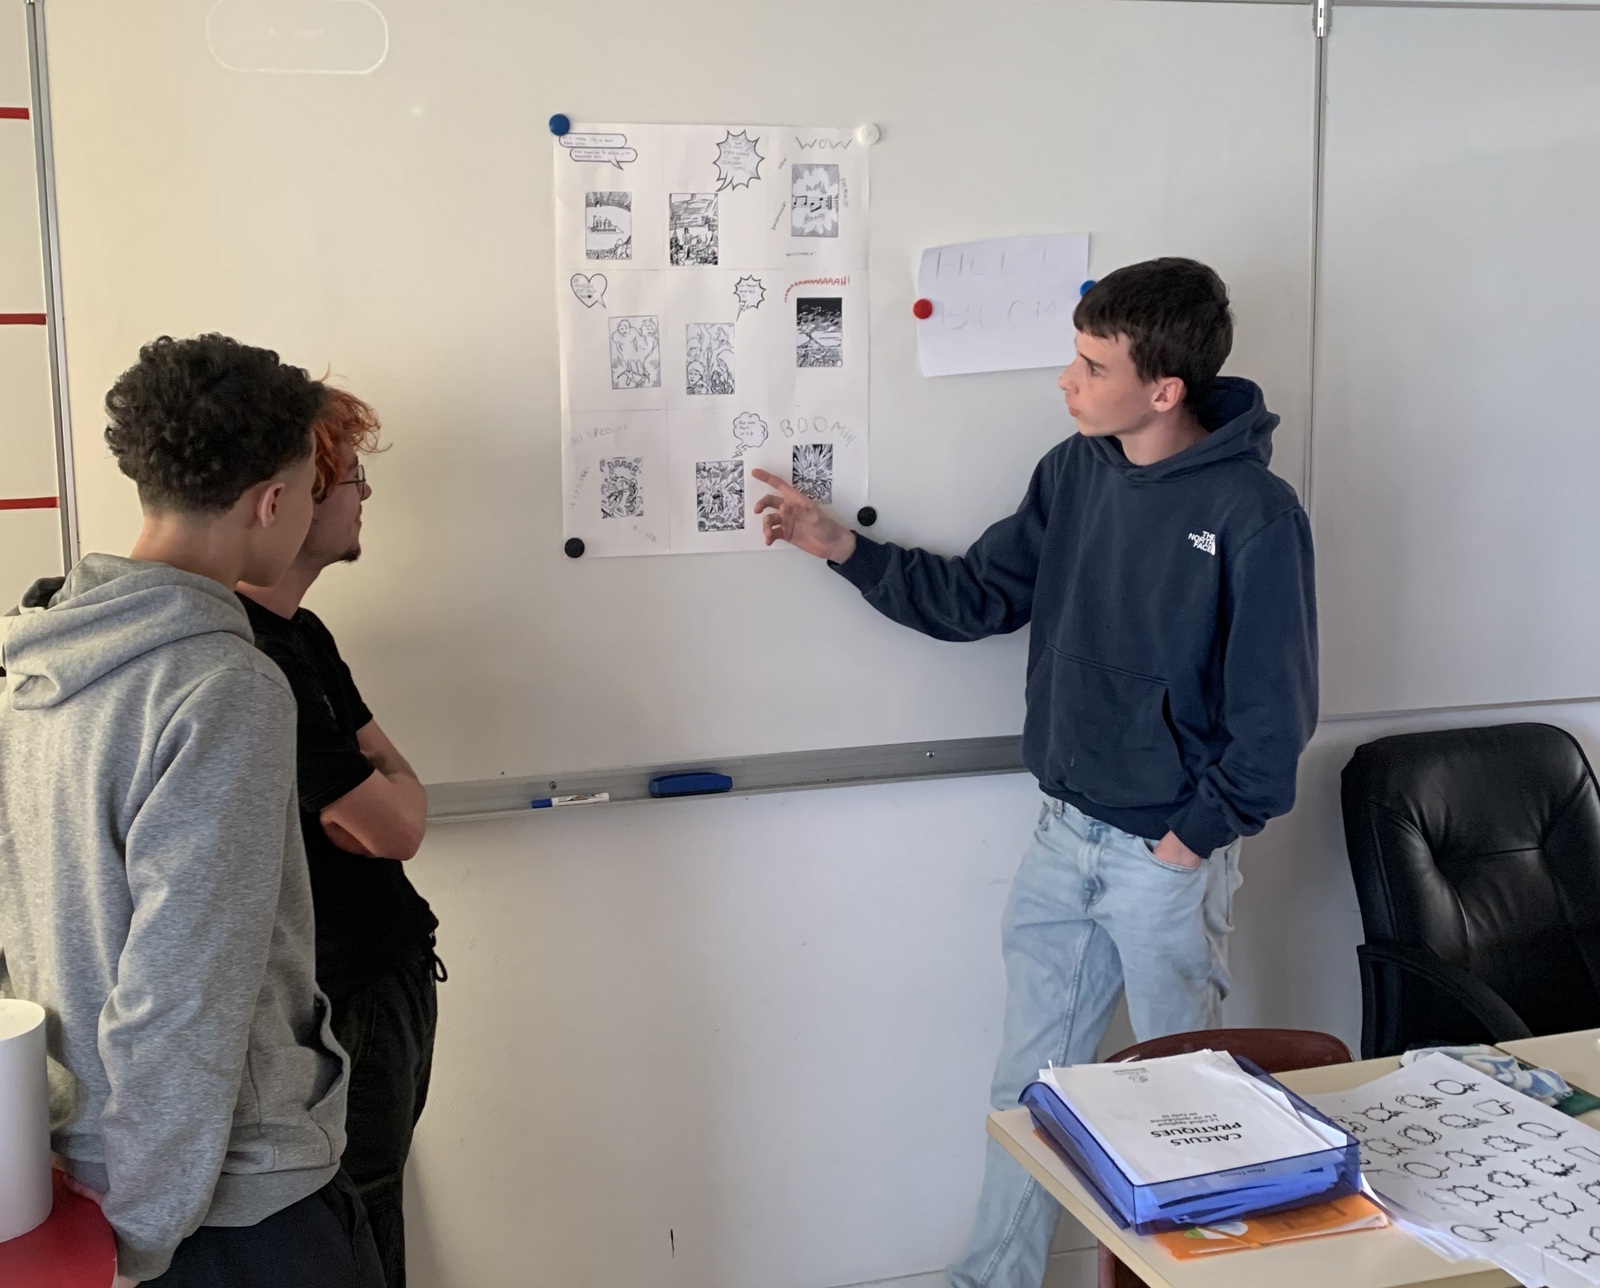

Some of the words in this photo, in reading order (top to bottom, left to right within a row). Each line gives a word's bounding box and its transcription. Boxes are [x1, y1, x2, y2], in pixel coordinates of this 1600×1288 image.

[795, 136, 853, 150] WOW
[1188, 532, 1214, 547] NORTH
[1202, 530, 1216, 541] THE
[1193, 540, 1213, 553] FACE
[1150, 1122, 1243, 1139] PRATIQUES
[1170, 1132, 1242, 1147] CALCULS
